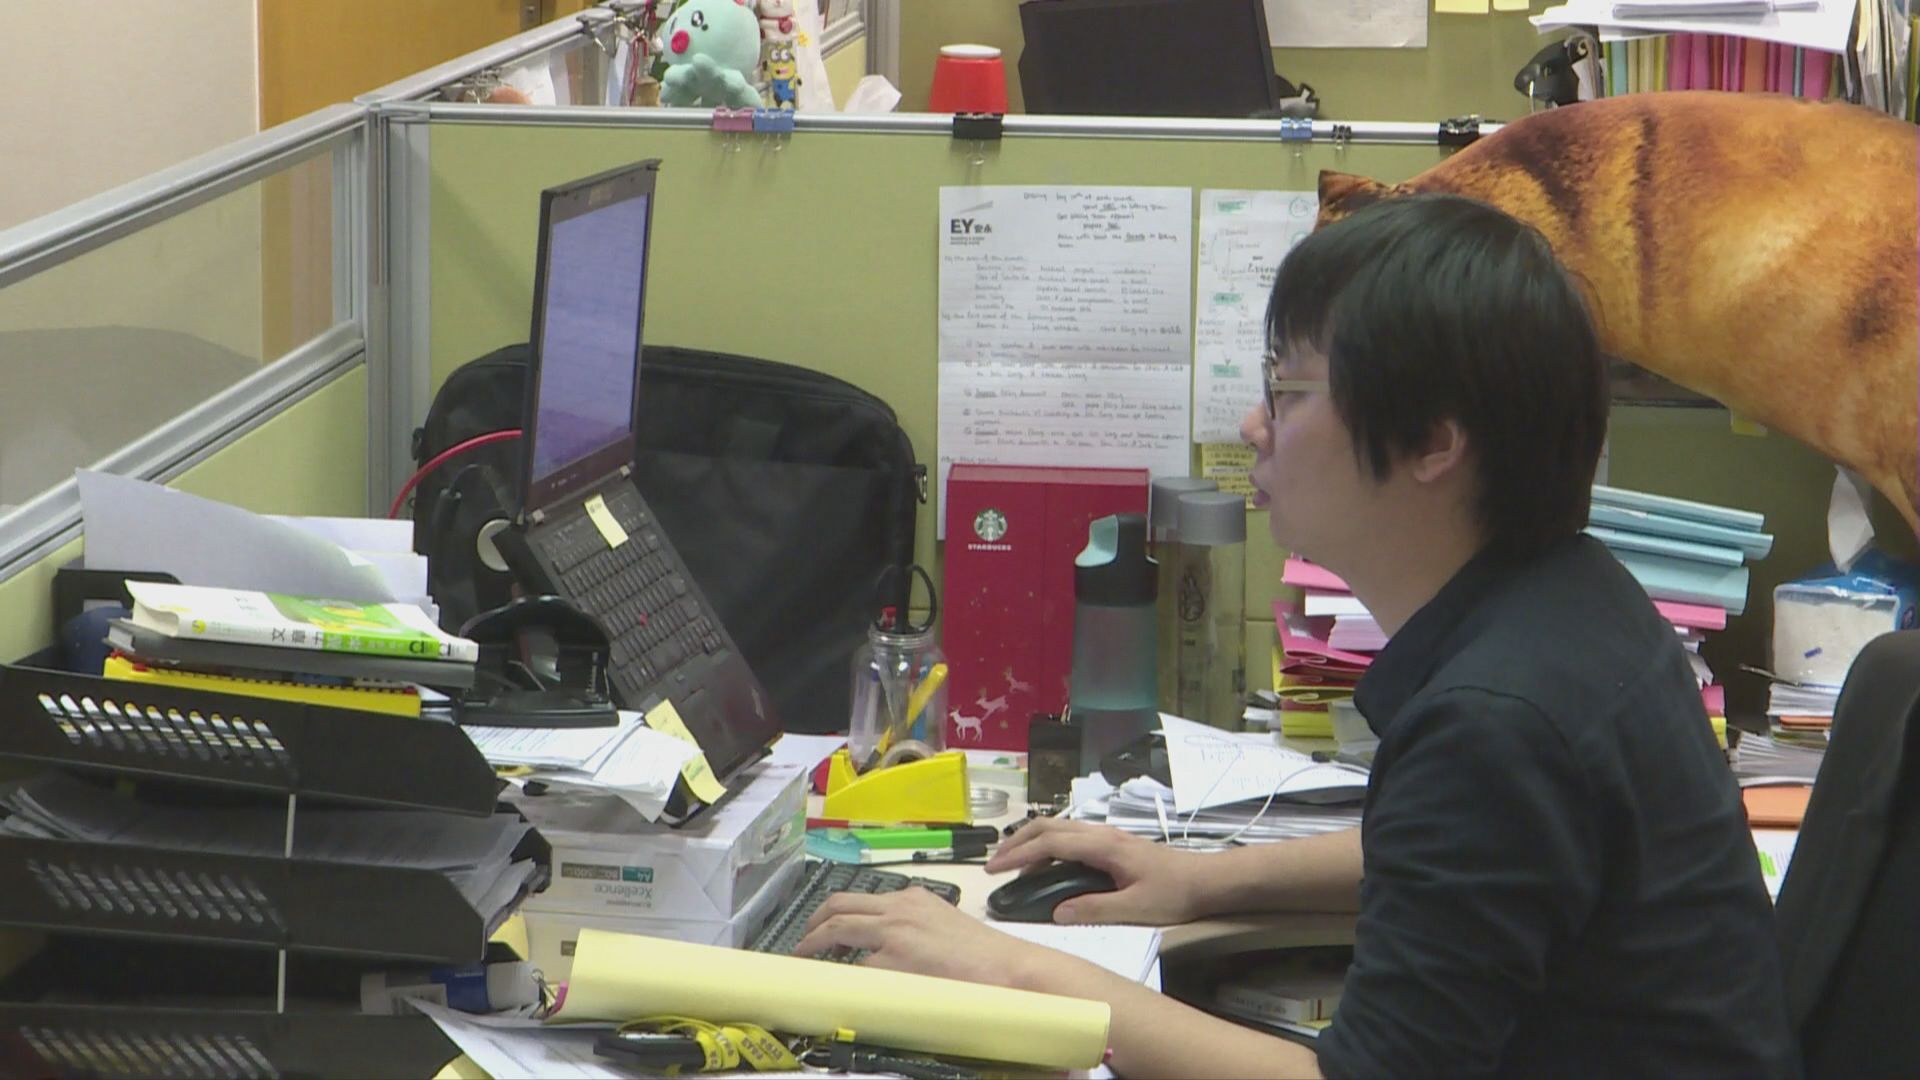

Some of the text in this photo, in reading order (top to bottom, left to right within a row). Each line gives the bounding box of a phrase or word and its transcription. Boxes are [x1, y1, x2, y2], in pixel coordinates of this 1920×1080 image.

[951, 219, 975, 233] EY
[967, 543, 1012, 551] STARBUCKS
[637, 871, 651, 882] A4
[594, 883, 653, 899] Xcellence
